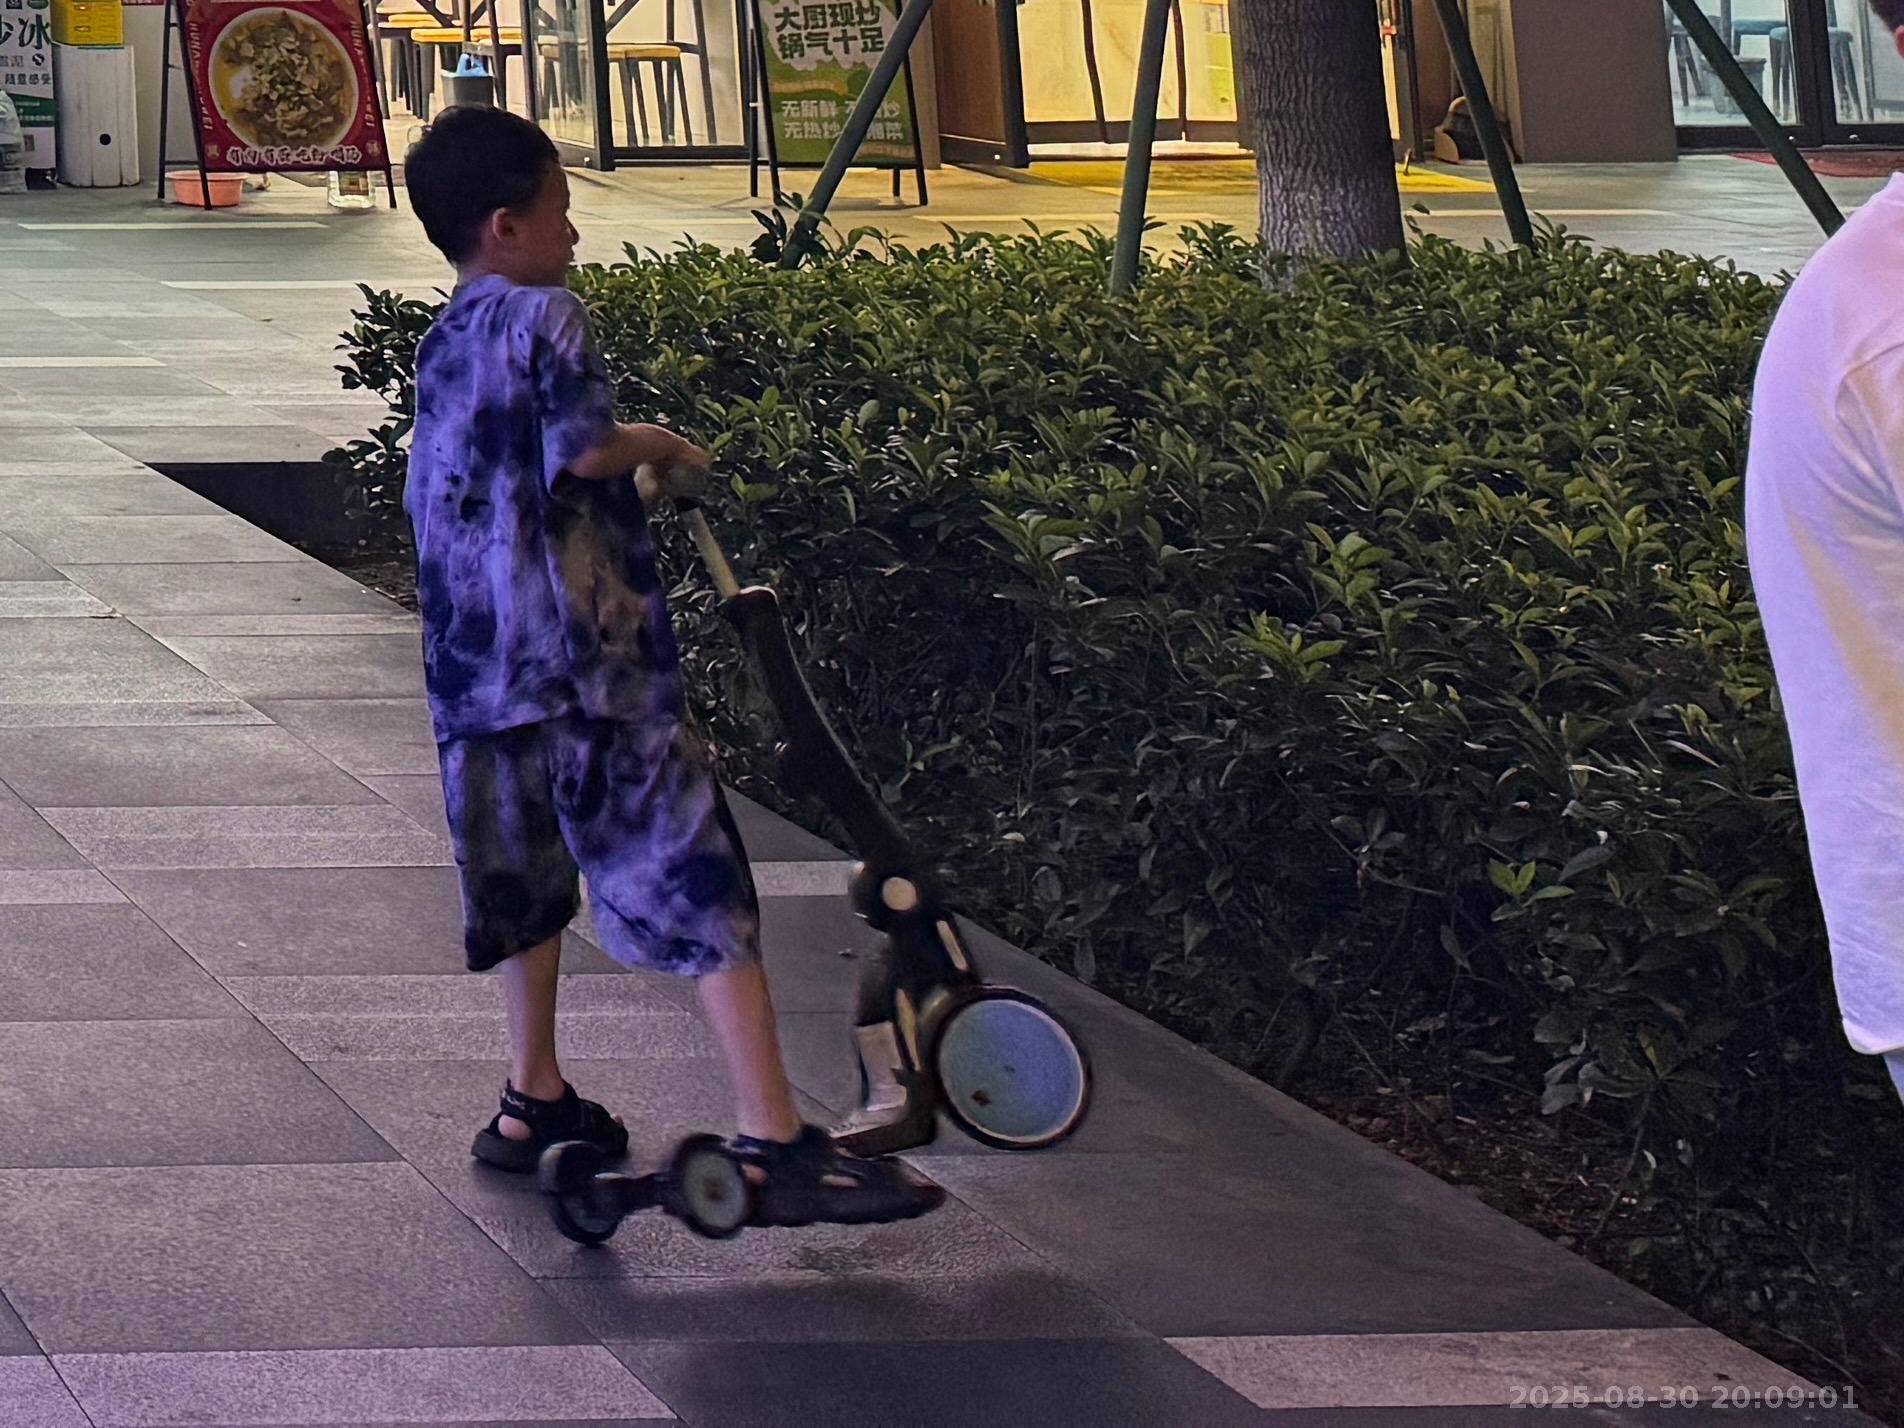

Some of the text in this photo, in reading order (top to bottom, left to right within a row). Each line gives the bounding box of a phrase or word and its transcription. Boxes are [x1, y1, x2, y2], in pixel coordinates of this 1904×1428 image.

[774, 0, 881, 33] 大厨现炒
[776, 26, 886, 60] 锅气十足
